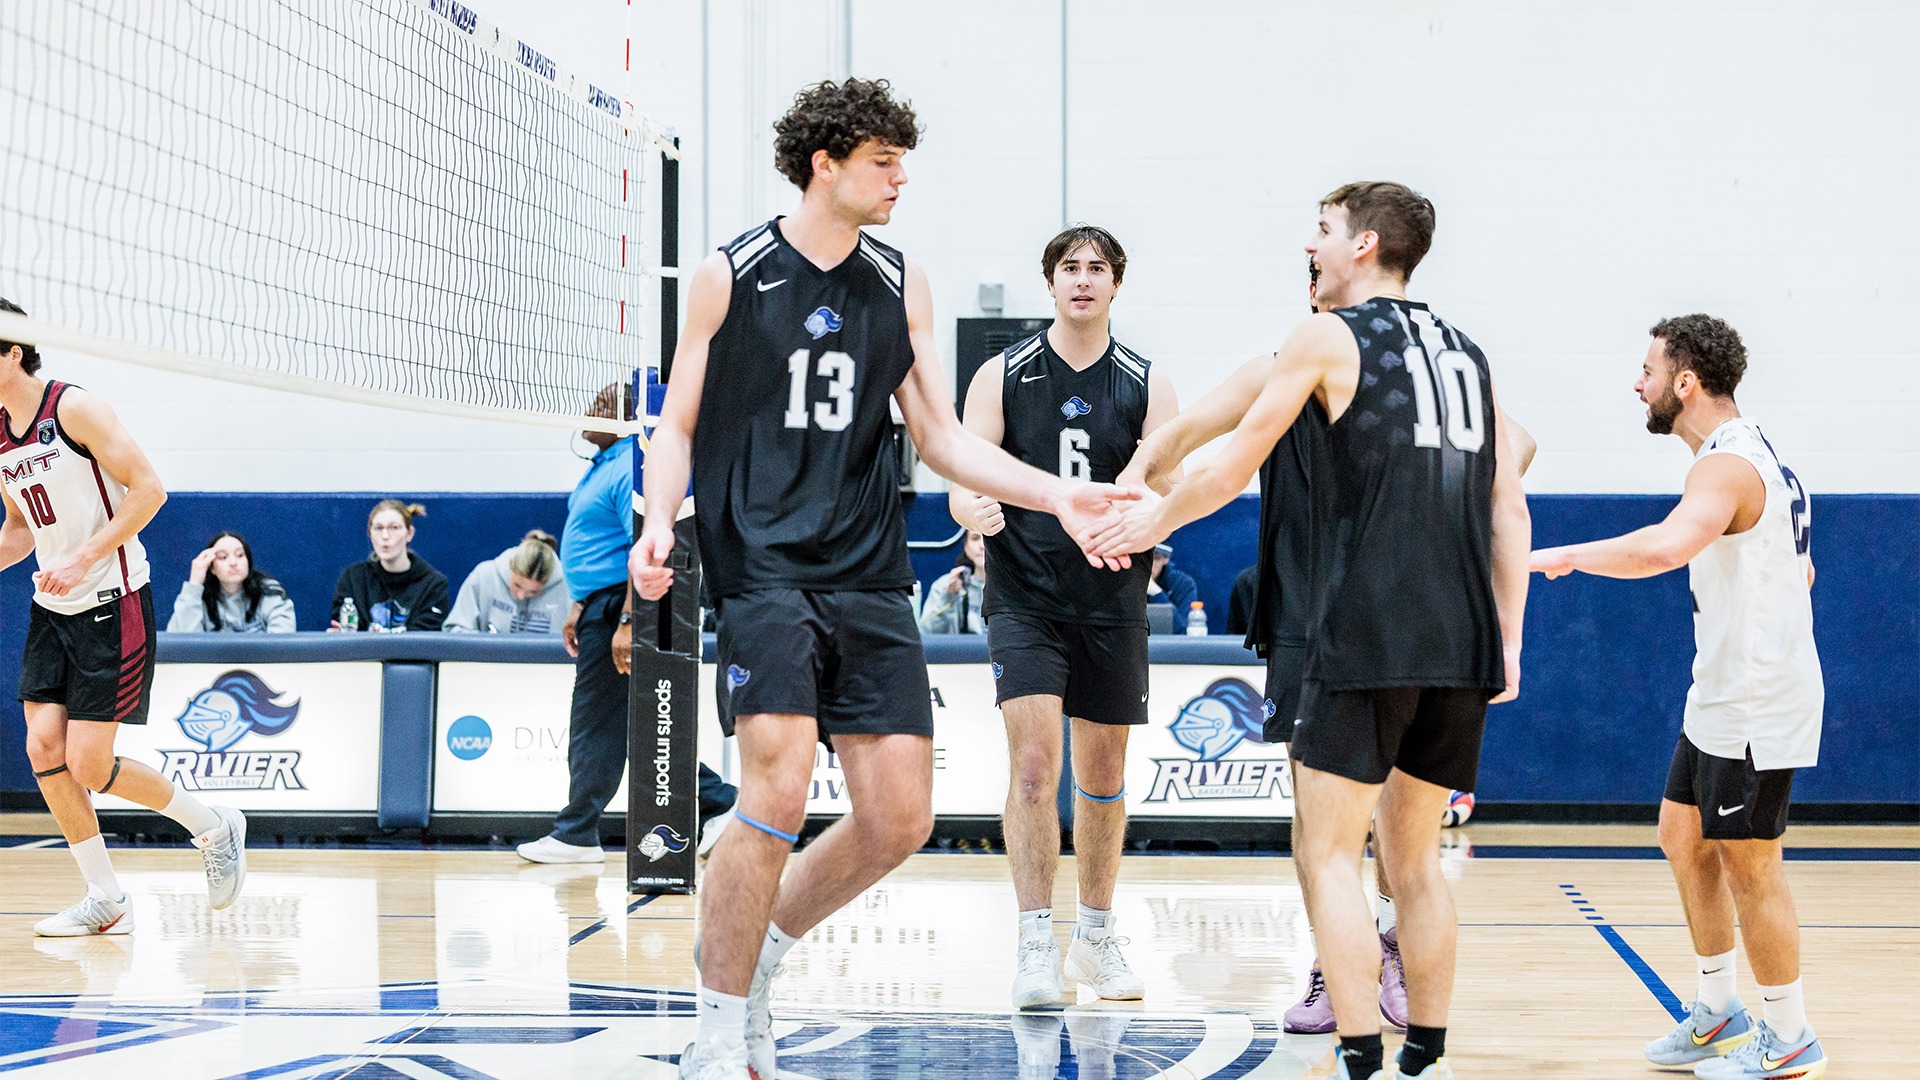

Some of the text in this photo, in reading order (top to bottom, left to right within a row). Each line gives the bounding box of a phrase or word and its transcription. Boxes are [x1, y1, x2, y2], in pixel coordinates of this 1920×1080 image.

[784, 349, 856, 432] 13
[1403, 344, 1486, 454] 10
[1, 448, 60, 484] MIT
[1059, 427, 1091, 482] 6
[21, 483, 57, 529] 10
[450, 735, 492, 751] NCAA
[653, 678, 673, 807] sports imports
[156, 749, 309, 792] RIVIER
[203, 778, 257, 787] VOLLEYBALL
[1141, 757, 1294, 804] RIVIER
[1197, 787, 1252, 796] BASKETBALL
